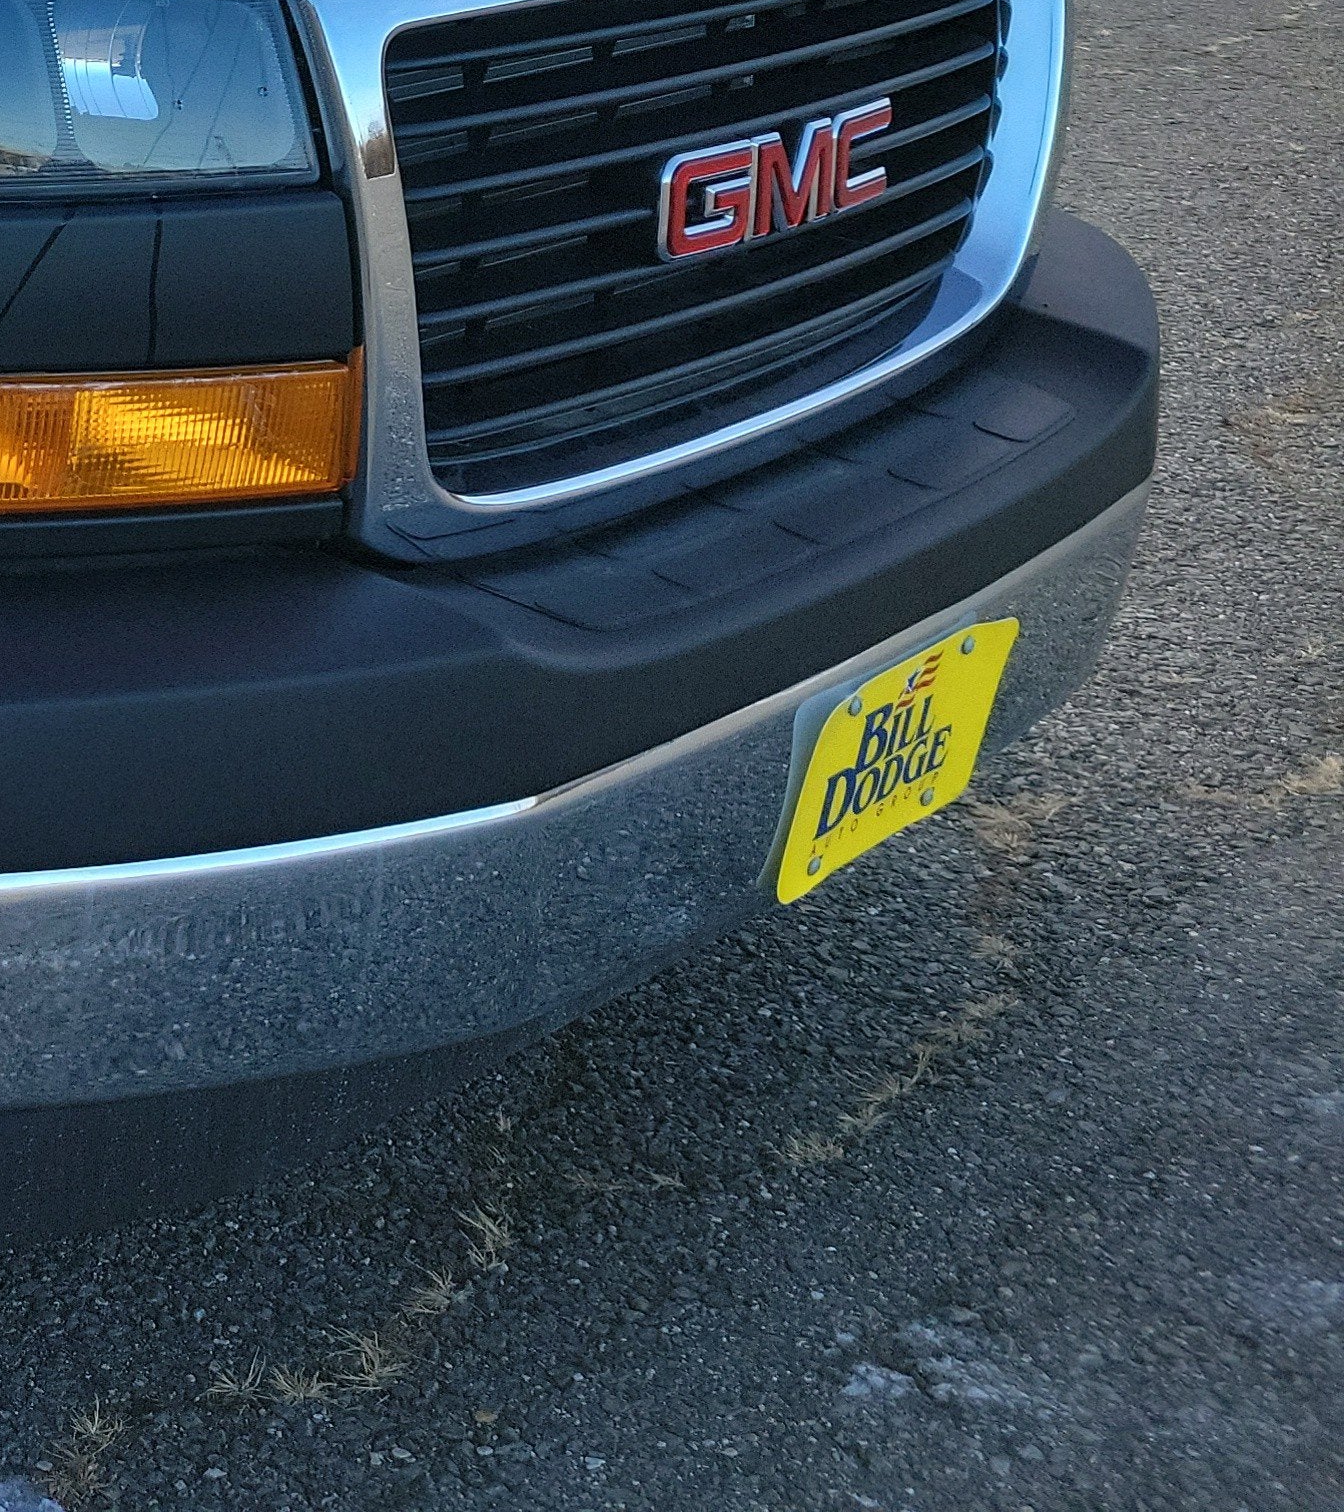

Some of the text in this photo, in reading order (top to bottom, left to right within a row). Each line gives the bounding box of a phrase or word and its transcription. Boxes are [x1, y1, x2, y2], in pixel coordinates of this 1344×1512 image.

[658, 97, 893, 261] GMC
[813, 724, 952, 840] DODGE
[855, 693, 935, 774] BILL
[810, 771, 939, 858] AUTO GROUP
